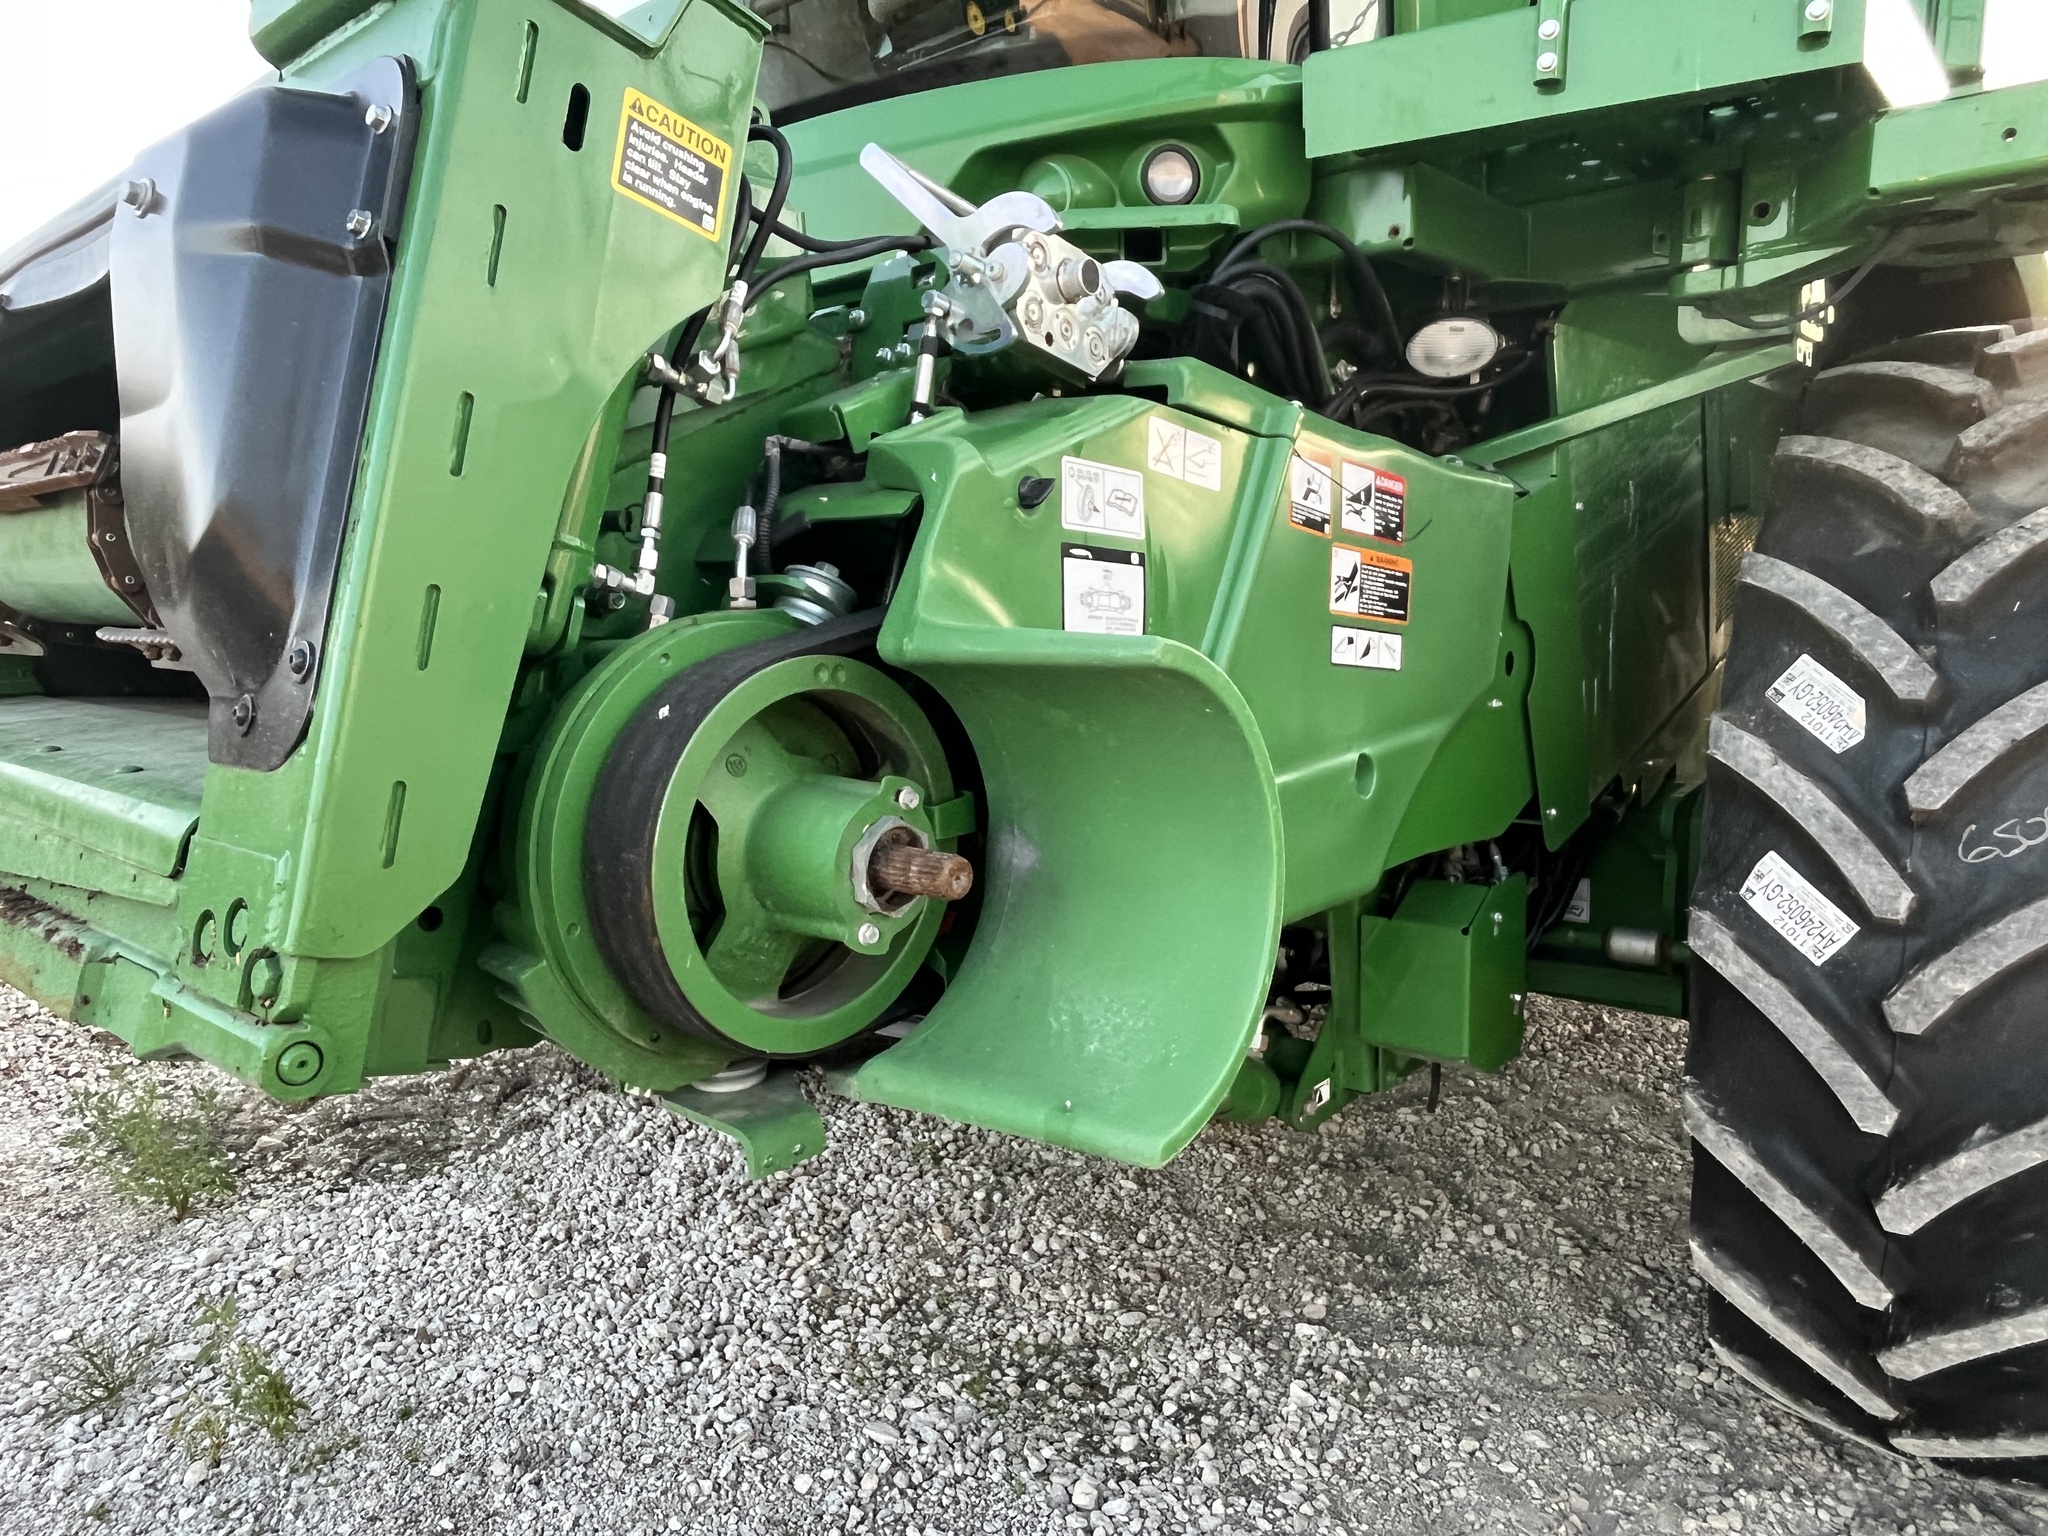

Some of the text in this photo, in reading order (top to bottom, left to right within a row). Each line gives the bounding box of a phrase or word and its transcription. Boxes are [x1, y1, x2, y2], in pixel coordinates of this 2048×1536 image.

[628, 133, 709, 186] injuries. Header
[630, 121, 706, 173] Avoid crushing
[646, 105, 726, 164] CAUTION
[622, 170, 677, 208] is running.
[624, 160, 714, 215] clear when engine
[626, 148, 692, 190] can tilt. Stay
[1800, 711, 1834, 741] 11012
[1957, 804, 2048, 864] 650
[1758, 878, 1842, 950] AH246052-GY
[1772, 915, 1808, 948] 11012
